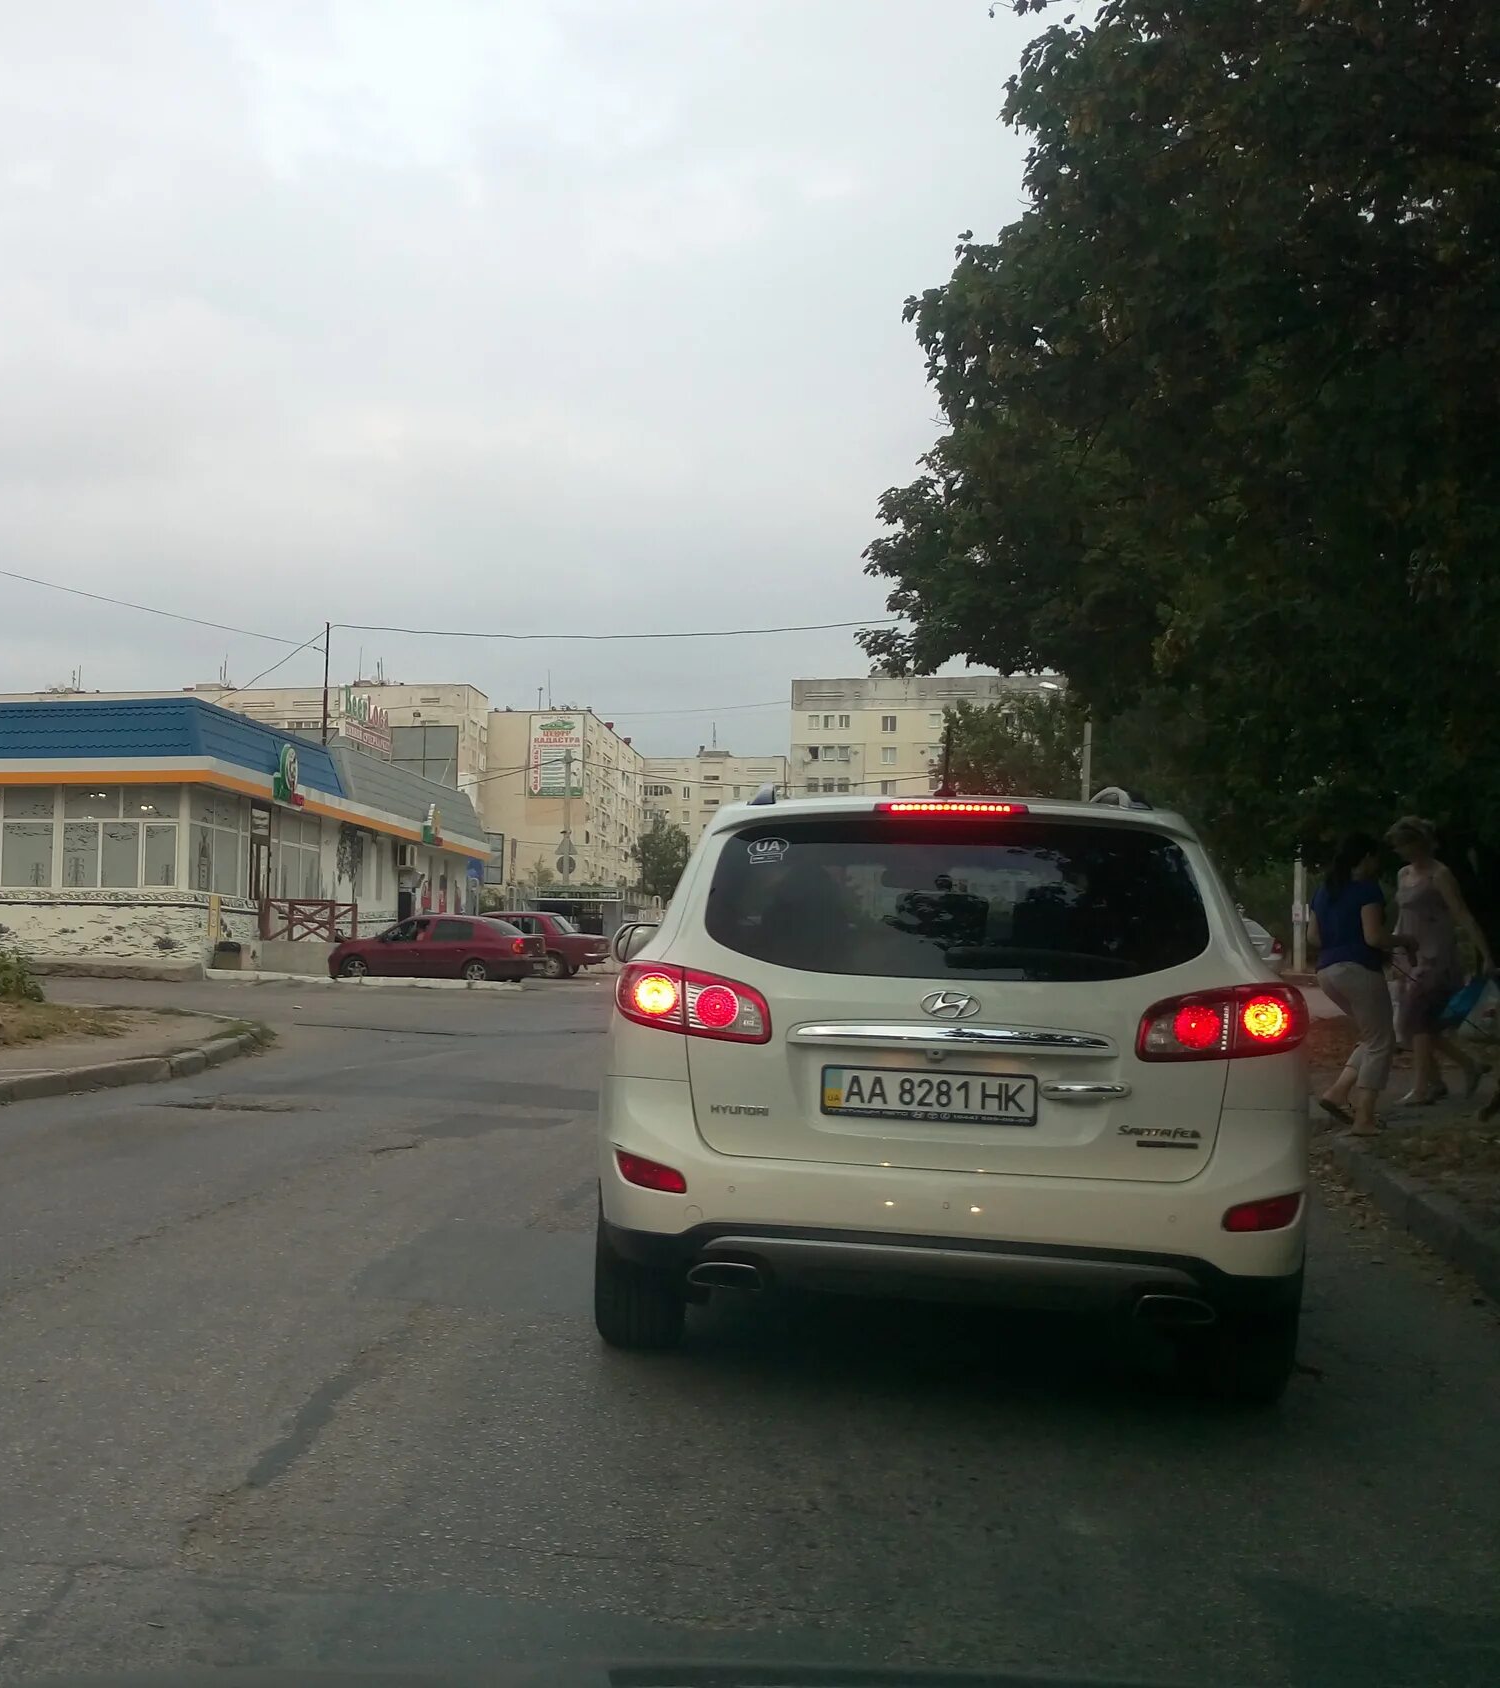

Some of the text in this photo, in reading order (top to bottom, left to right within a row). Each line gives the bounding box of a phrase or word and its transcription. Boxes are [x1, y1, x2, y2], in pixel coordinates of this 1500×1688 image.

[756, 841, 781, 852] UA
[844, 1074, 1026, 1113] AA 8281 HK
[710, 1104, 769, 1117] HYUNDAI
